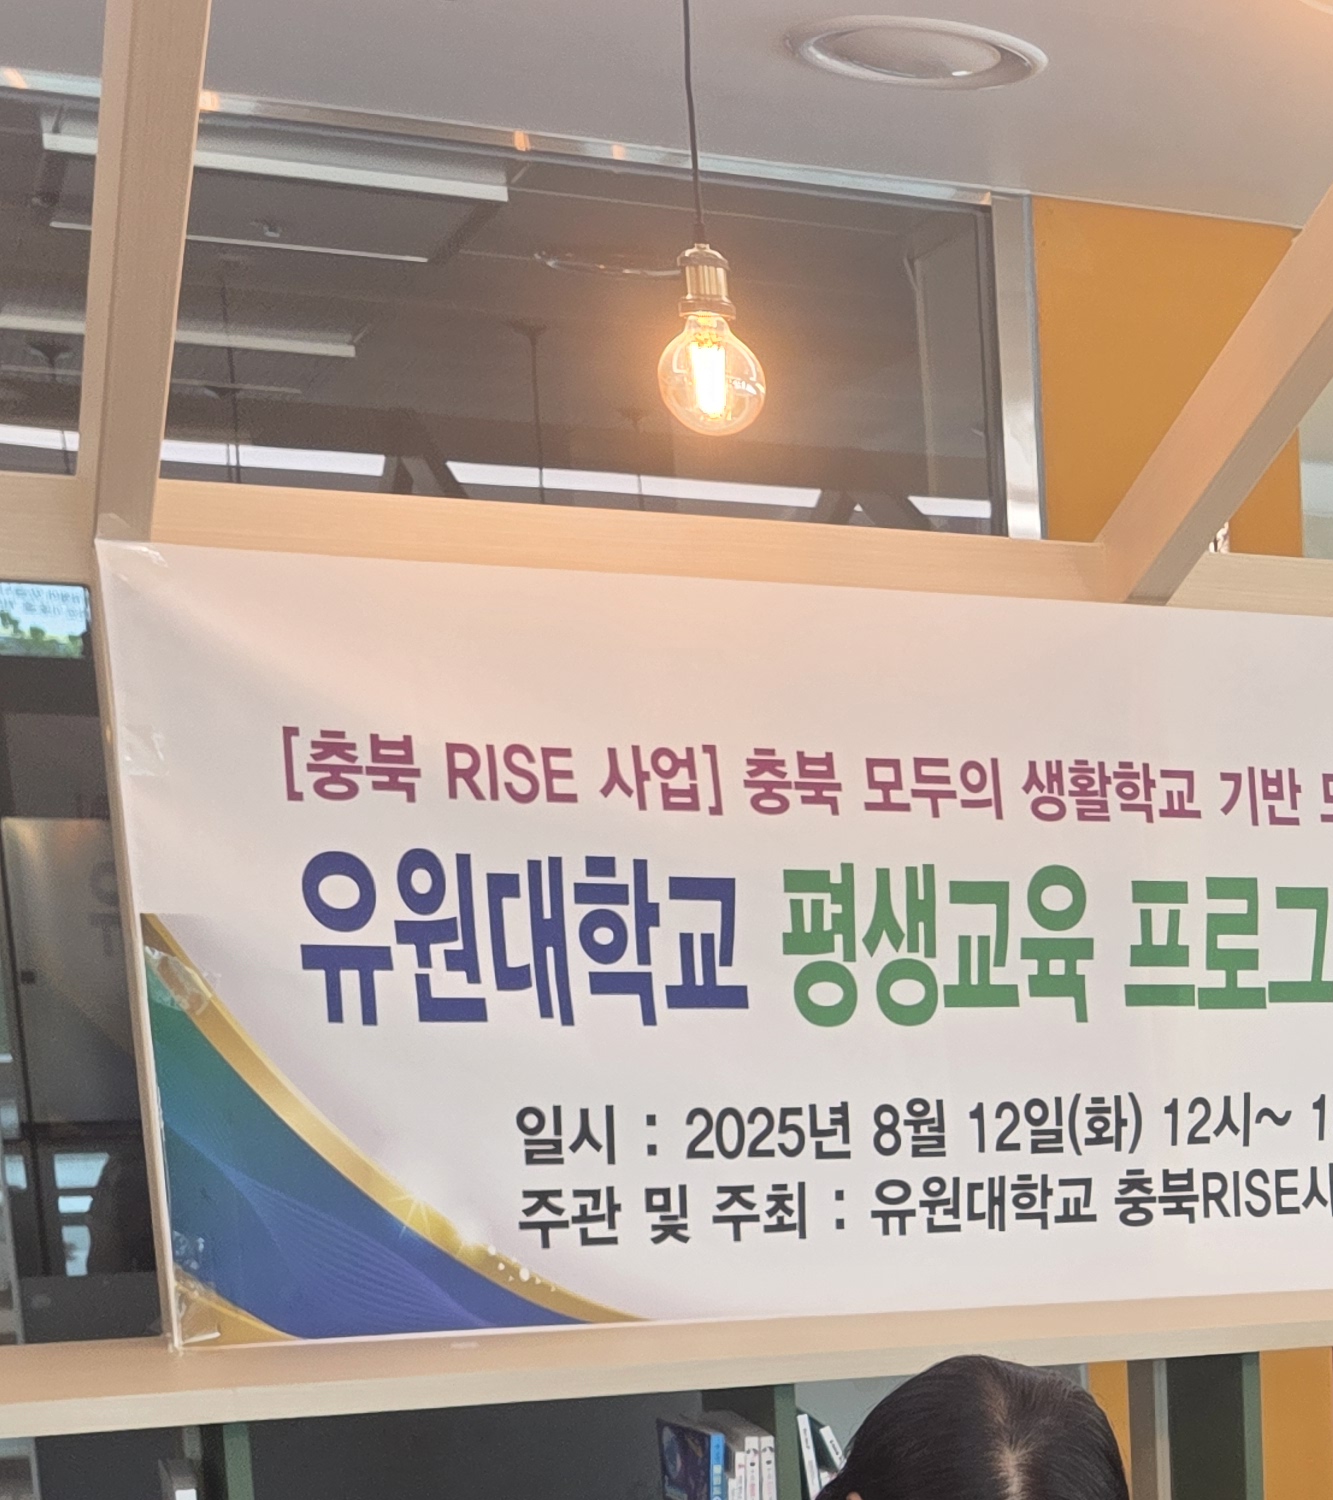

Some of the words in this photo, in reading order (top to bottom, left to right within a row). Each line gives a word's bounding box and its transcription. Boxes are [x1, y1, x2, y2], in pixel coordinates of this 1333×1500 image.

[282, 725, 422, 804] [충북
[445, 742, 579, 805] RISE
[599, 744, 724, 816] 사업]
[743, 747, 843, 816] 충북
[863, 756, 1004, 821] 모두의
[1021, 759, 1202, 824] 생활학교
[1219, 766, 1302, 827] 기반
[300, 847, 750, 1027] 유원대학교
[782, 862, 1095, 1028] 평생교육
[515, 1104, 616, 1166] 일시
[645, 1113, 658, 1156] :
[685, 1101, 852, 1160] 2025년
[873, 1097, 947, 1158] 8월
[969, 1091, 1143, 1156] 12일(화)
[1163, 1091, 1292, 1147] 12시~
[518, 1185, 622, 1250] 주관
[644, 1183, 691, 1245] 및
[712, 1181, 807, 1242] 주최
[834, 1189, 845, 1230] :
[870, 1173, 1098, 1236] 유원대학교
